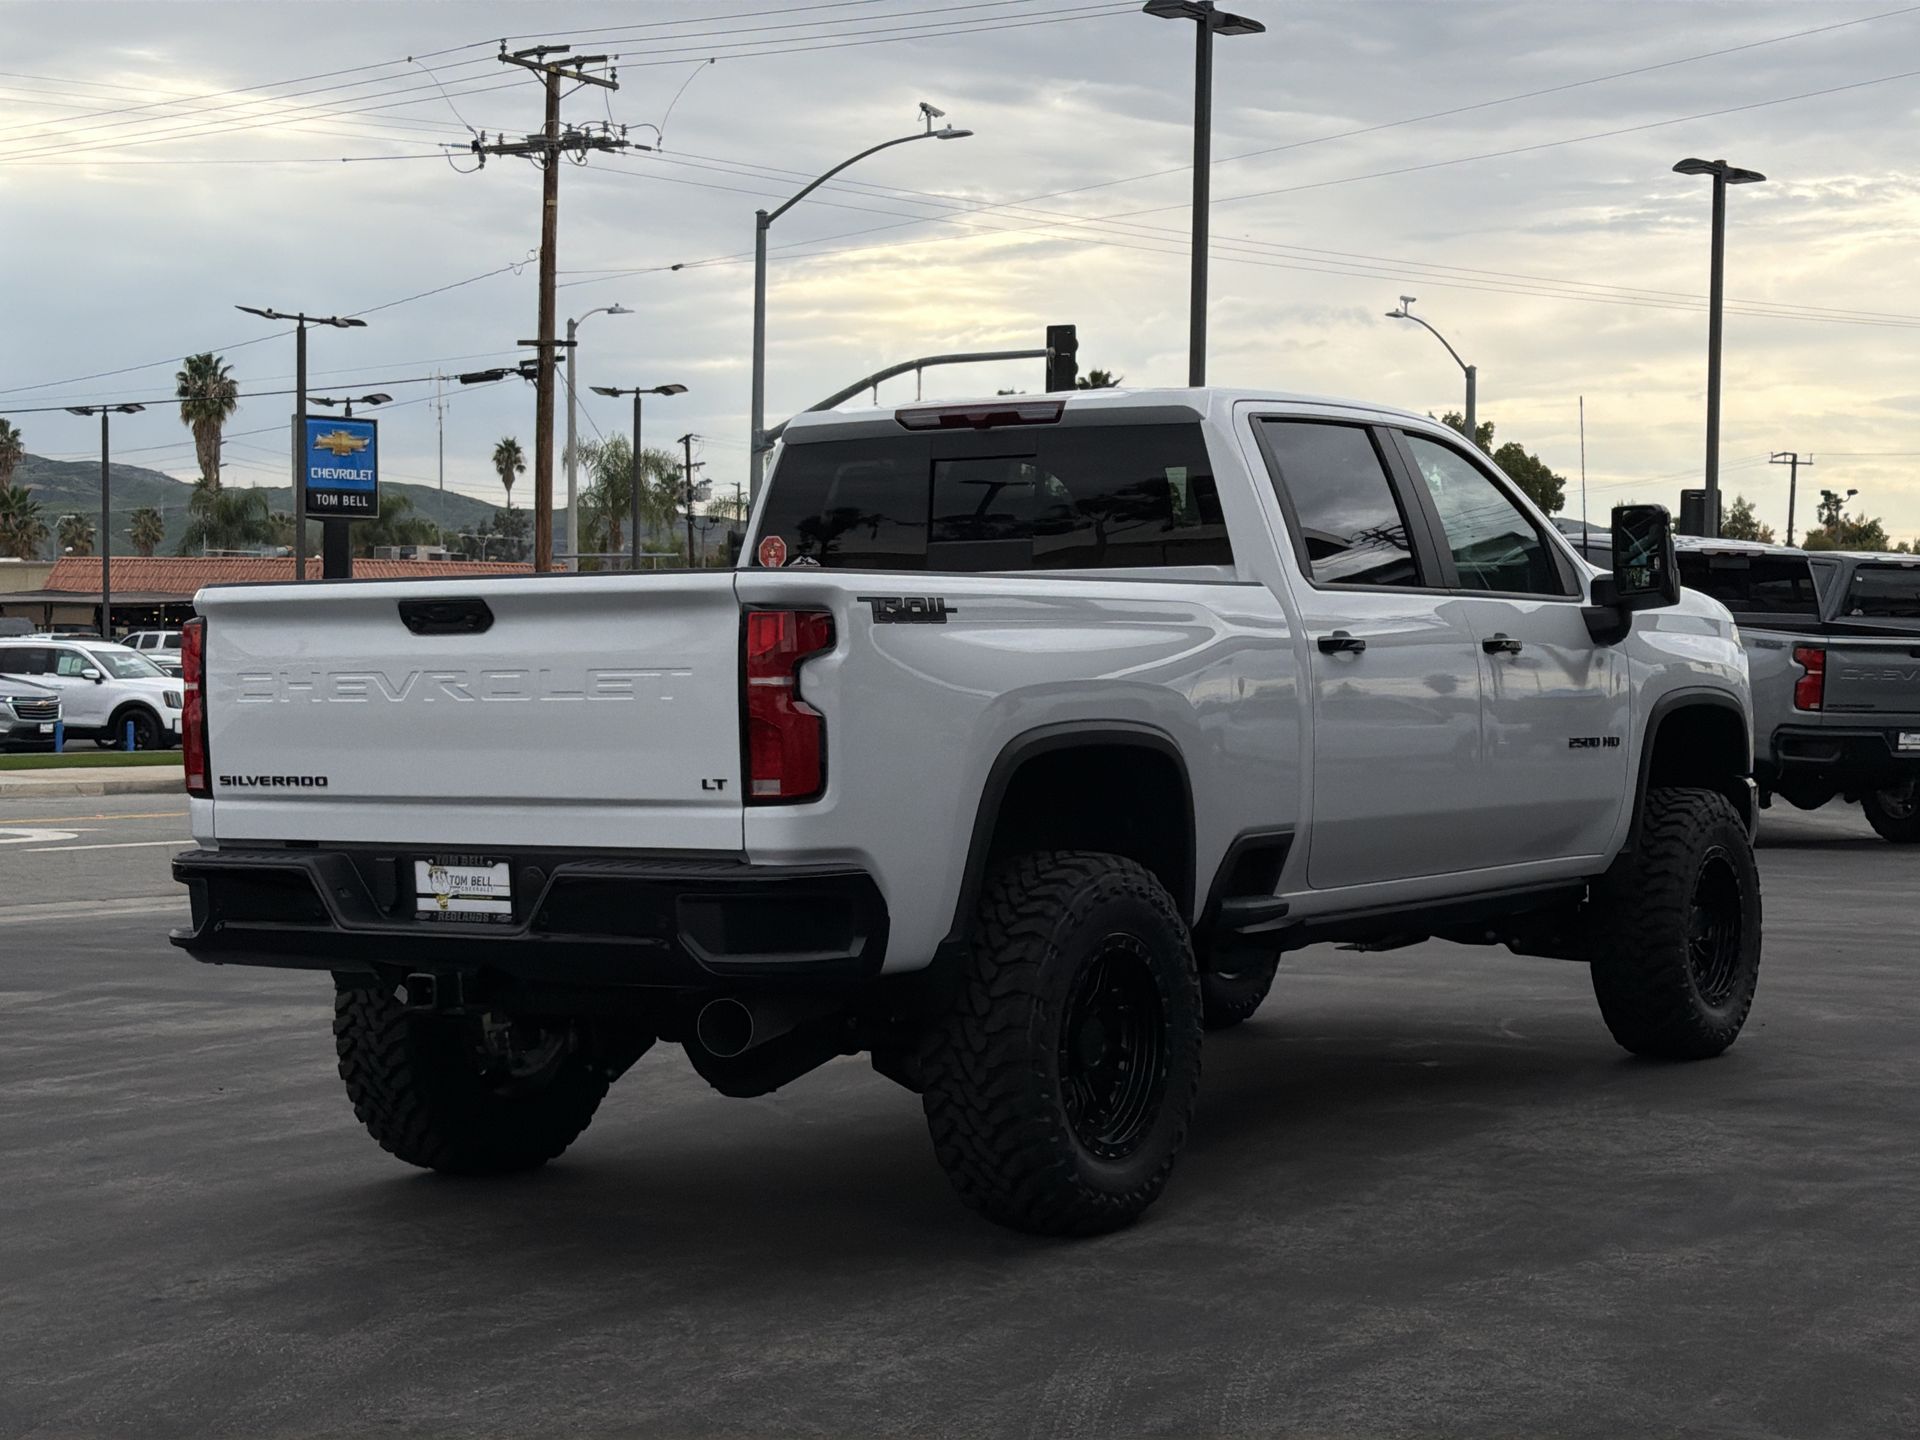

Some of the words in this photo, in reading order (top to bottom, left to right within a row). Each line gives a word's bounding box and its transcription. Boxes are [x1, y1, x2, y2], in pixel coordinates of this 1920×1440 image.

[310, 467, 373, 480] CHEVROLET
[316, 494, 338, 505] TOM
[343, 495, 368, 507] BELL
[1840, 668, 1920, 681] CHEV
[236, 668, 692, 702] CHEVROLET
[1568, 737, 1600, 748] 2500
[1602, 736, 1620, 747] HD
[219, 775, 328, 787] SILVERADO
[701, 779, 728, 790] LT
[436, 855, 459, 865] TOM
[461, 856, 484, 866] BELL
[449, 875, 468, 885] TOM
[471, 876, 492, 887] BELL
[438, 912, 489, 921] REDLANDS
